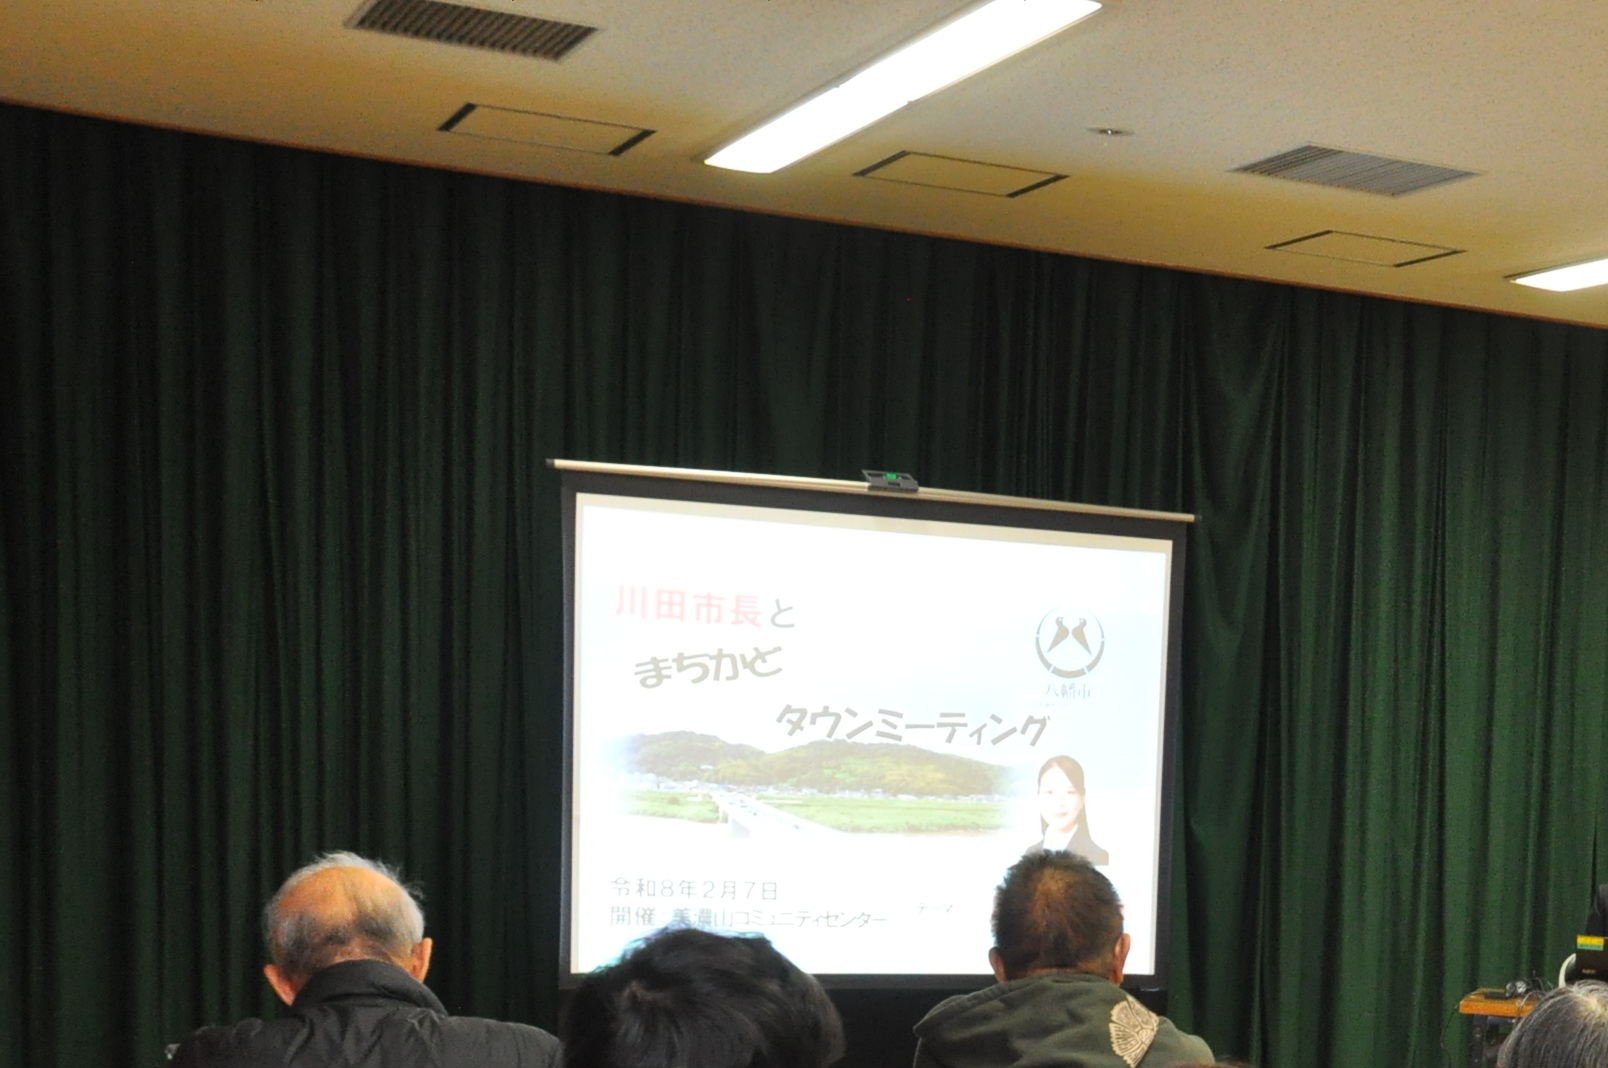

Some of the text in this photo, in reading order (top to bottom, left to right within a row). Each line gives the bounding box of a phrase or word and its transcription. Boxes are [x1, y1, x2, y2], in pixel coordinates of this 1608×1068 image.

[615, 584, 795, 628] 川田市長と
[776, 703, 1051, 747] タウンミーティング
